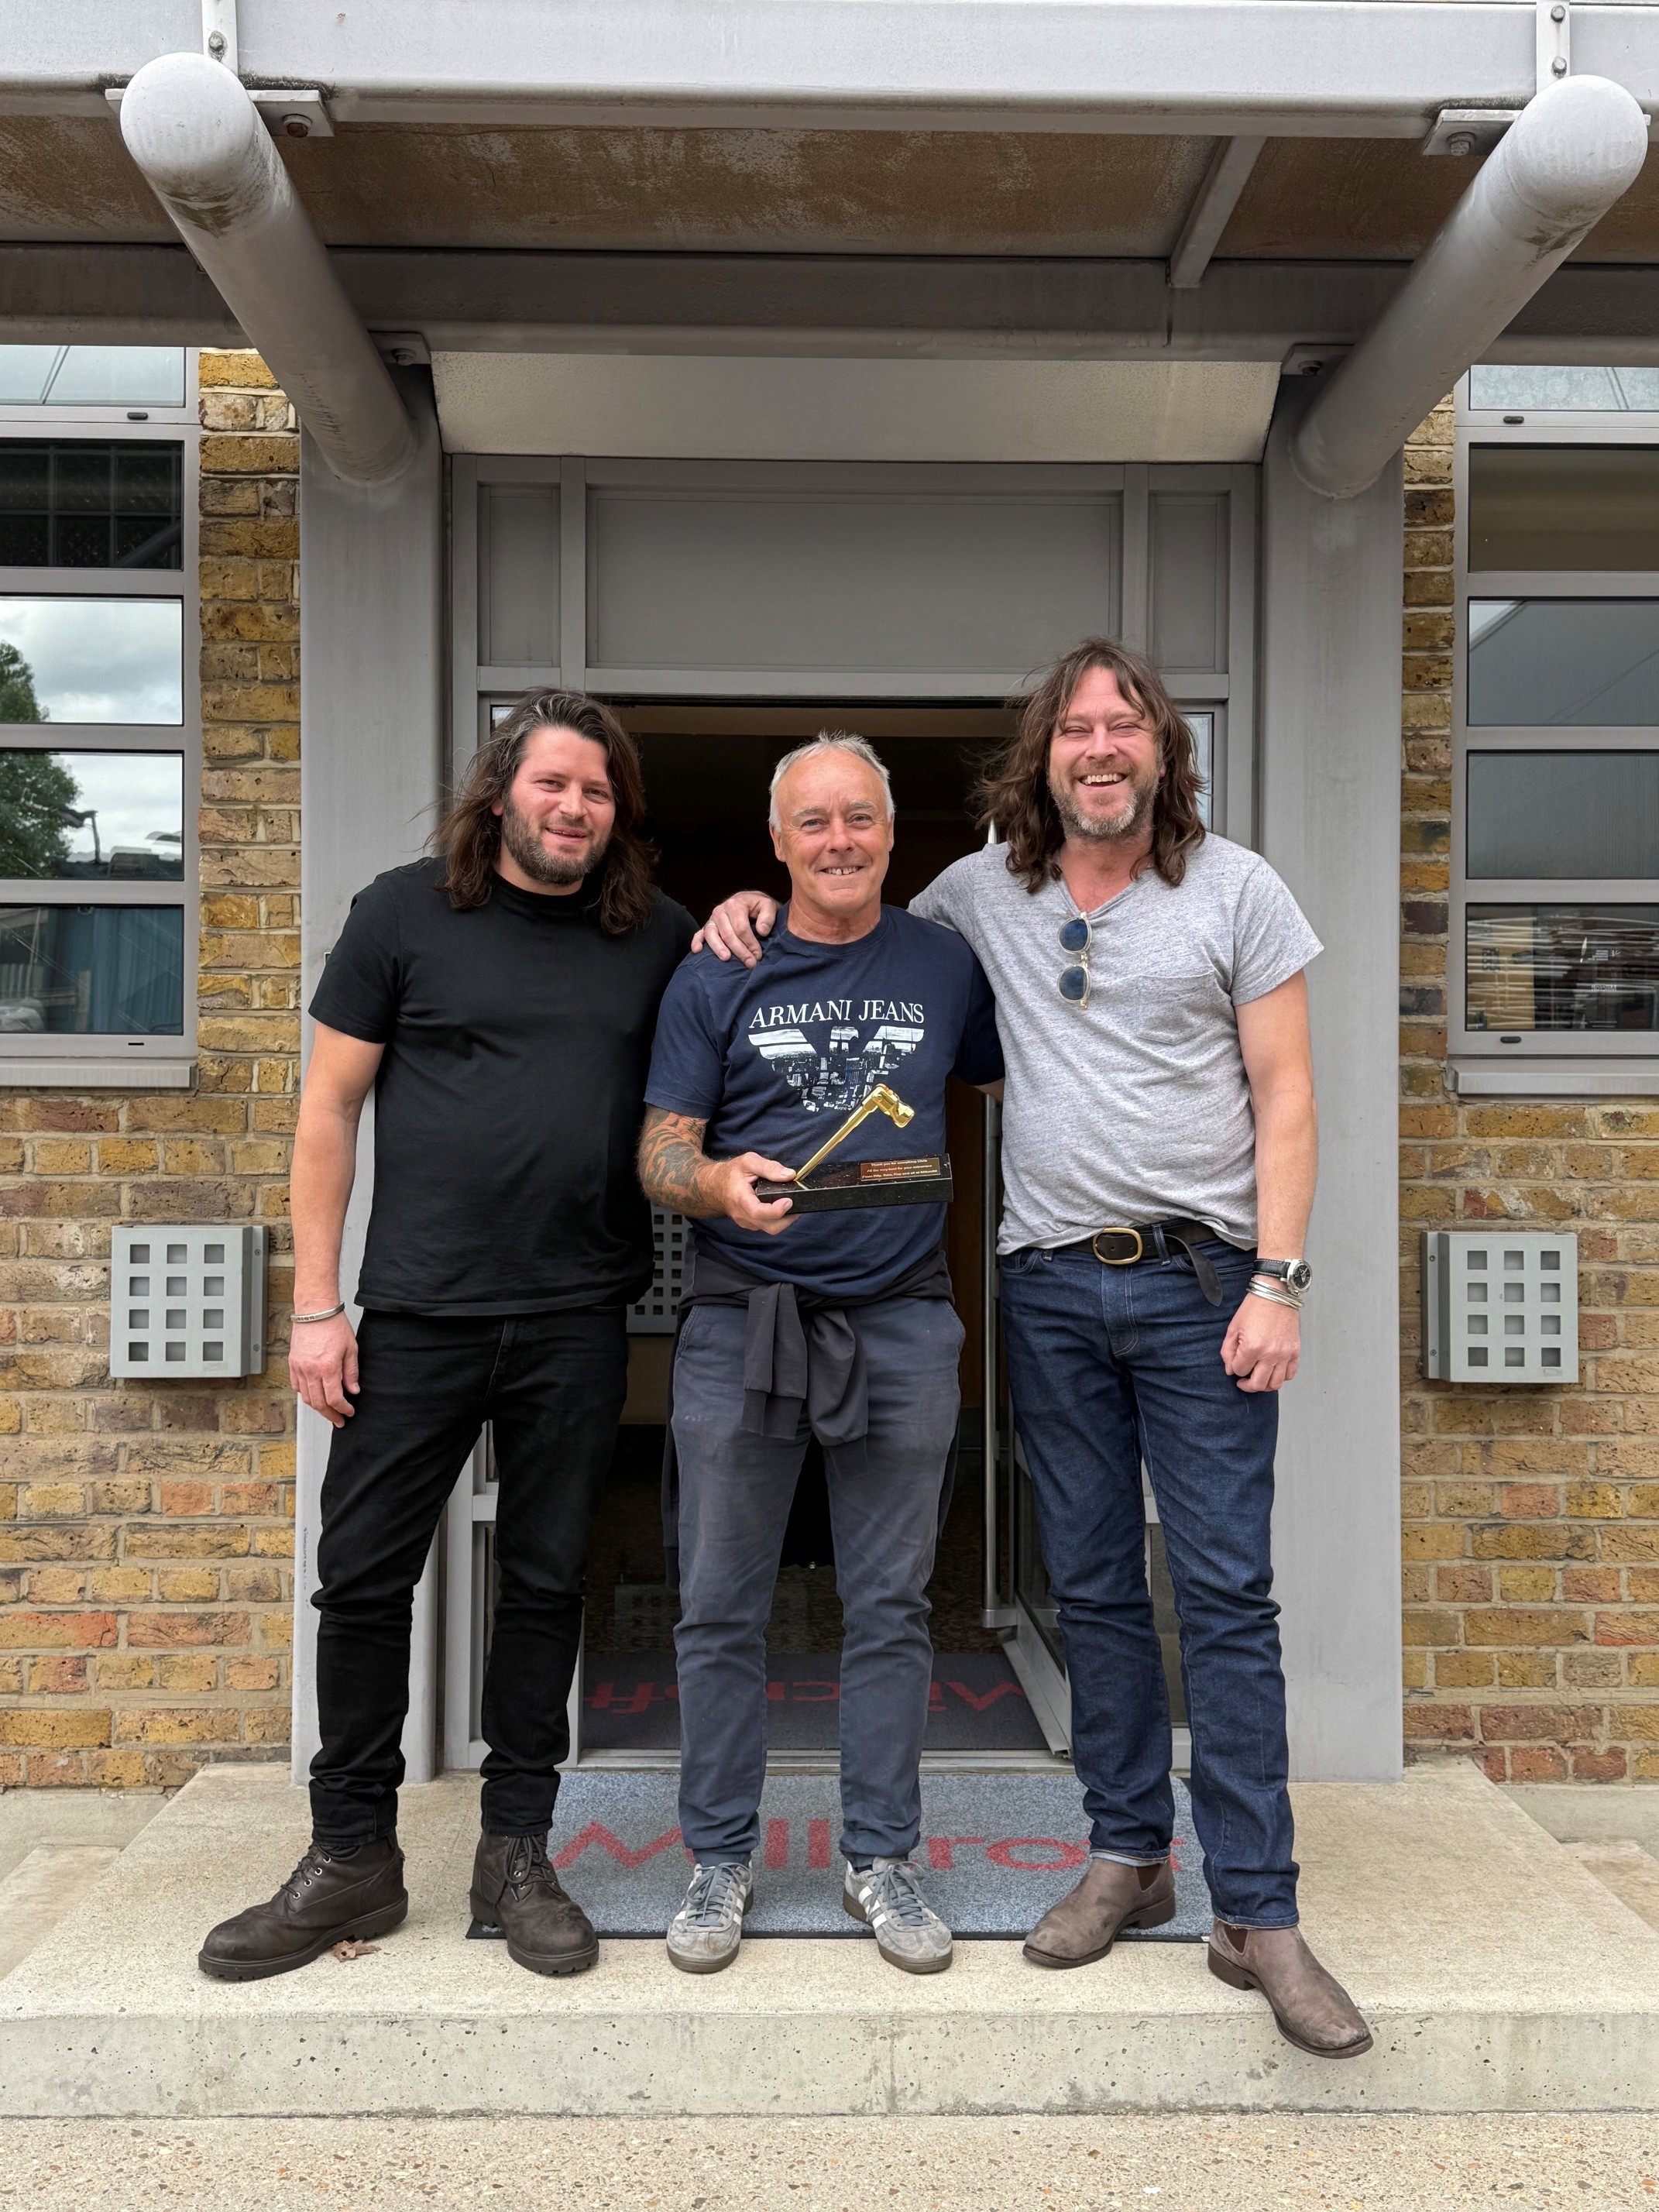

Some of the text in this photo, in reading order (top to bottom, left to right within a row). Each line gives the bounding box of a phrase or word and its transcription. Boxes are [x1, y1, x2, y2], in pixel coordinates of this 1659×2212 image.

[748, 999, 925, 1029] ARMANI JEANS
[552, 1818, 1185, 1870] Mllro
